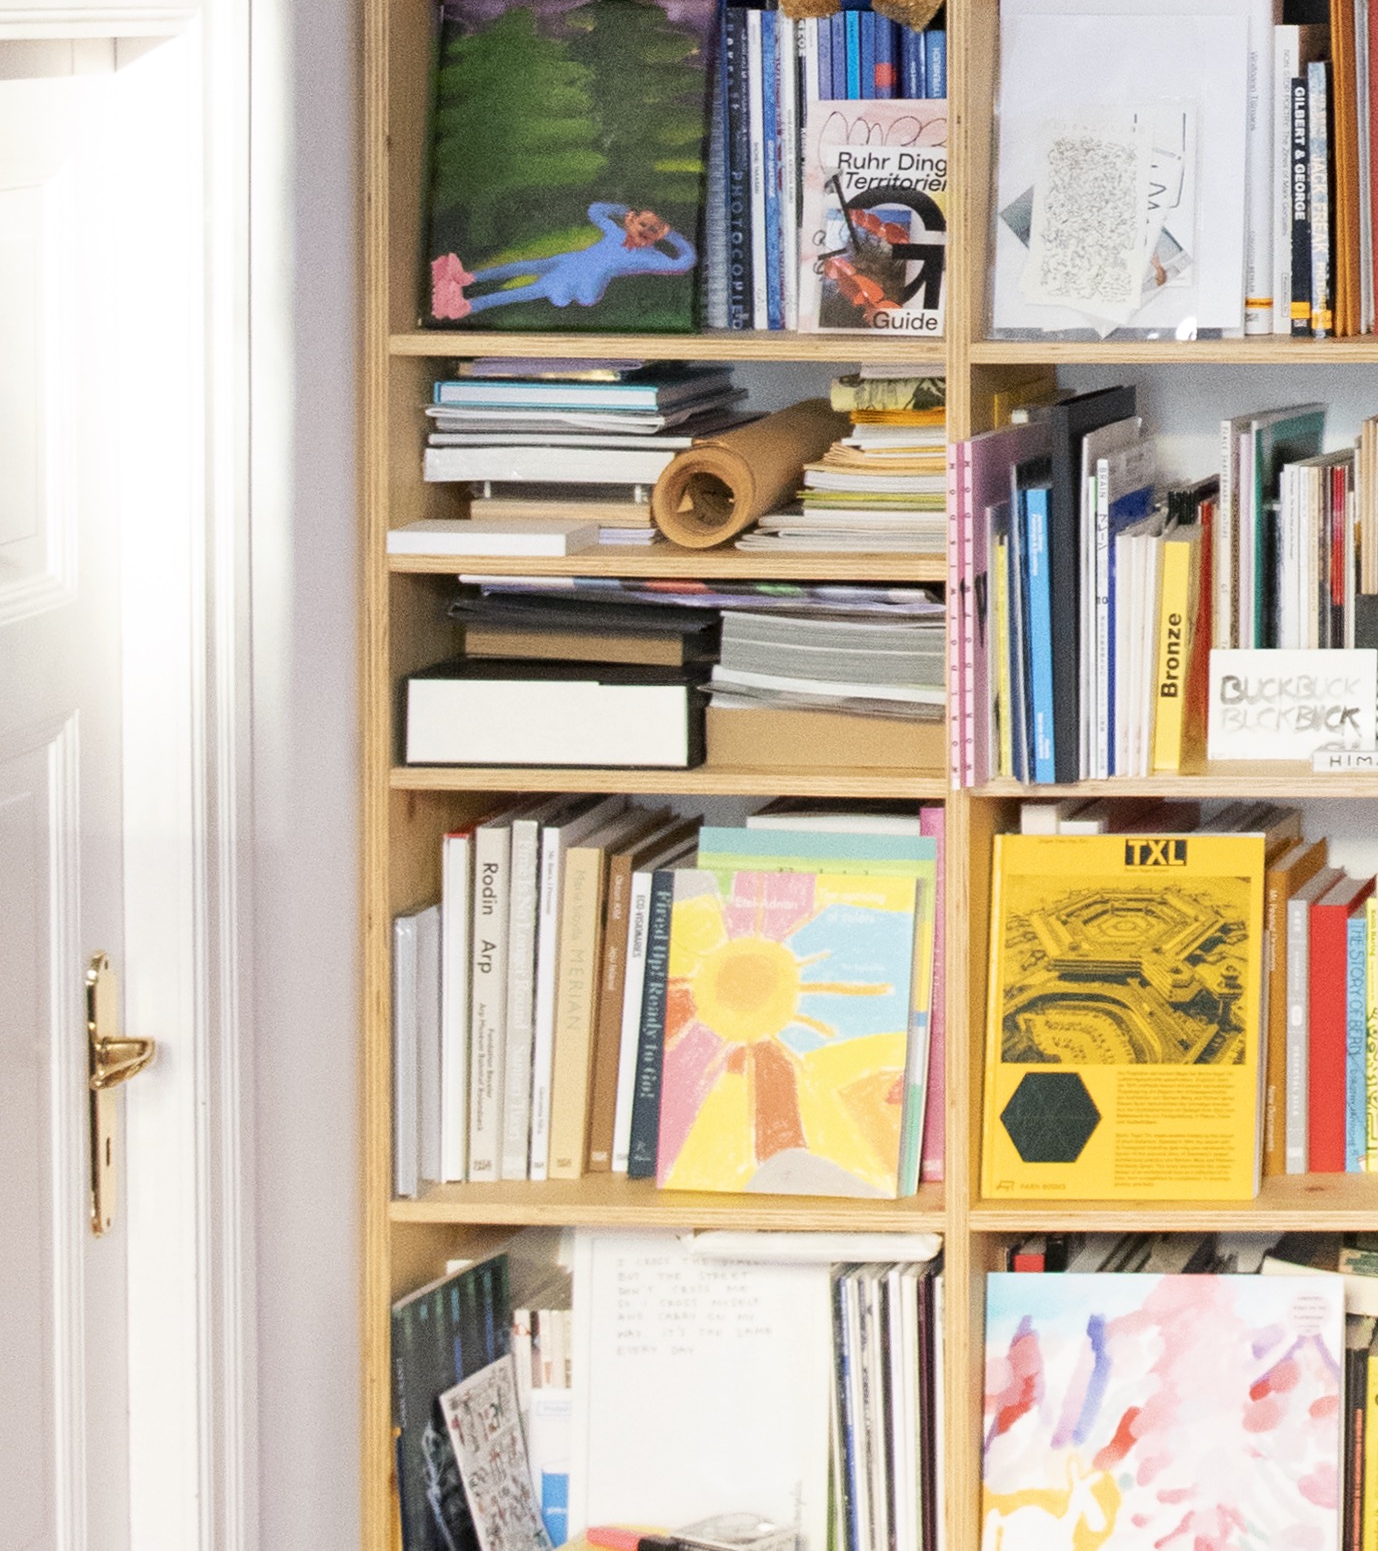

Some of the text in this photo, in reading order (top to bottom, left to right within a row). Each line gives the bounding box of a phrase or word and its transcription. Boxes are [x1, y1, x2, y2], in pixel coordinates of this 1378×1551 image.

[838, 151, 948, 178] Ruhr Ding
[1294, 86, 1306, 221] GILBERT & GEORGE
[872, 310, 938, 330] Guide
[1159, 612, 1182, 699] Bronze
[1125, 839, 1187, 867] TXL
[477, 862, 499, 974] Rodin Arp
